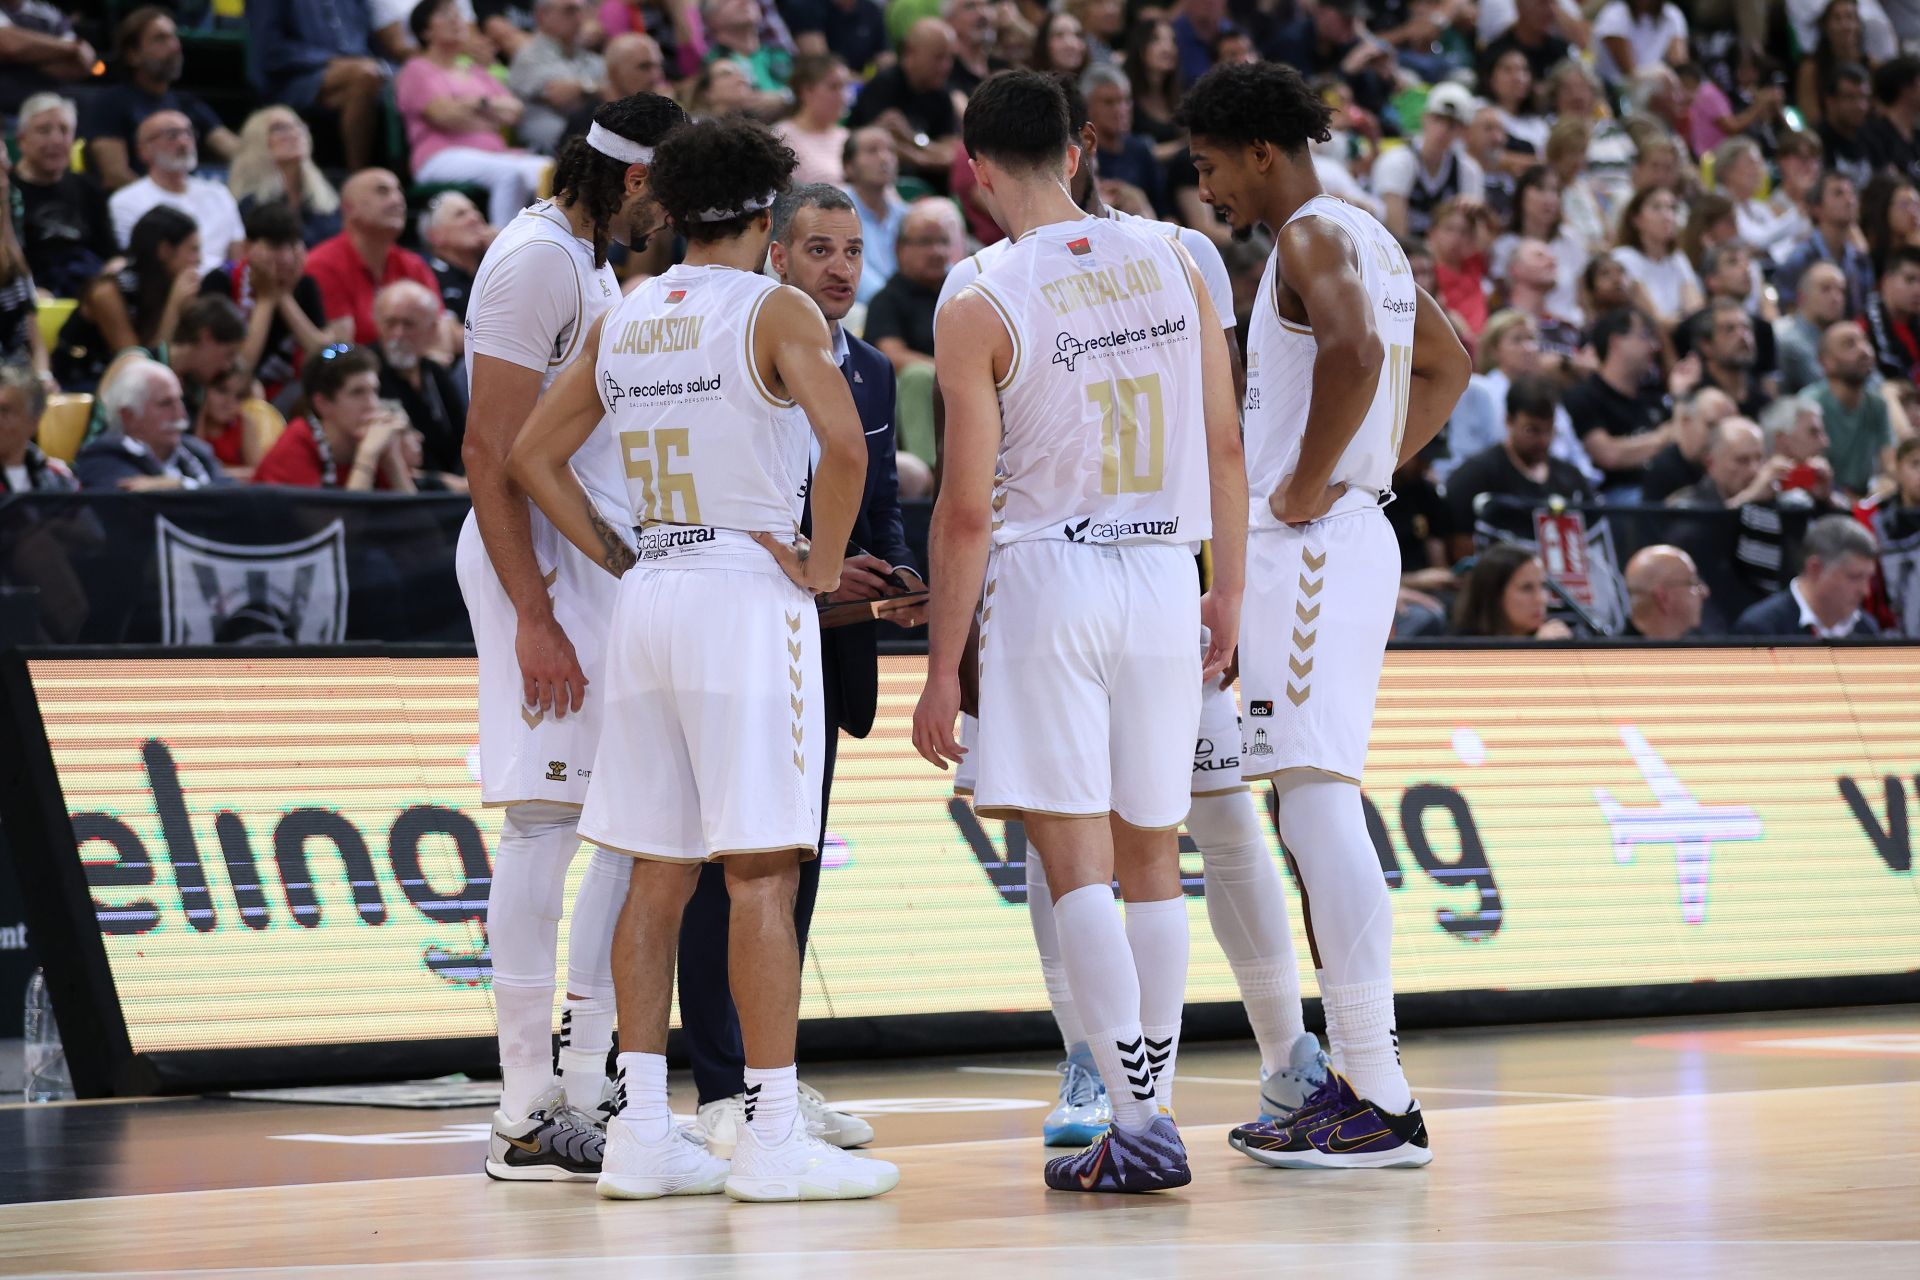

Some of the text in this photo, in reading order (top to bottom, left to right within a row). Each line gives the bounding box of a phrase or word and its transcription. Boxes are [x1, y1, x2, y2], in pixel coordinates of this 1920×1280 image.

[612, 315, 704, 355] JACKSON
[1151, 315, 1186, 337] salud
[629, 374, 721, 398] recoletas salud
[1086, 373, 1165, 495] 10
[620, 428, 702, 525] 56
[643, 528, 715, 551] cajarural
[1091, 516, 1179, 539] cajarural
[1192, 757, 1239, 772] XUS
[1837, 774, 1920, 870] v
